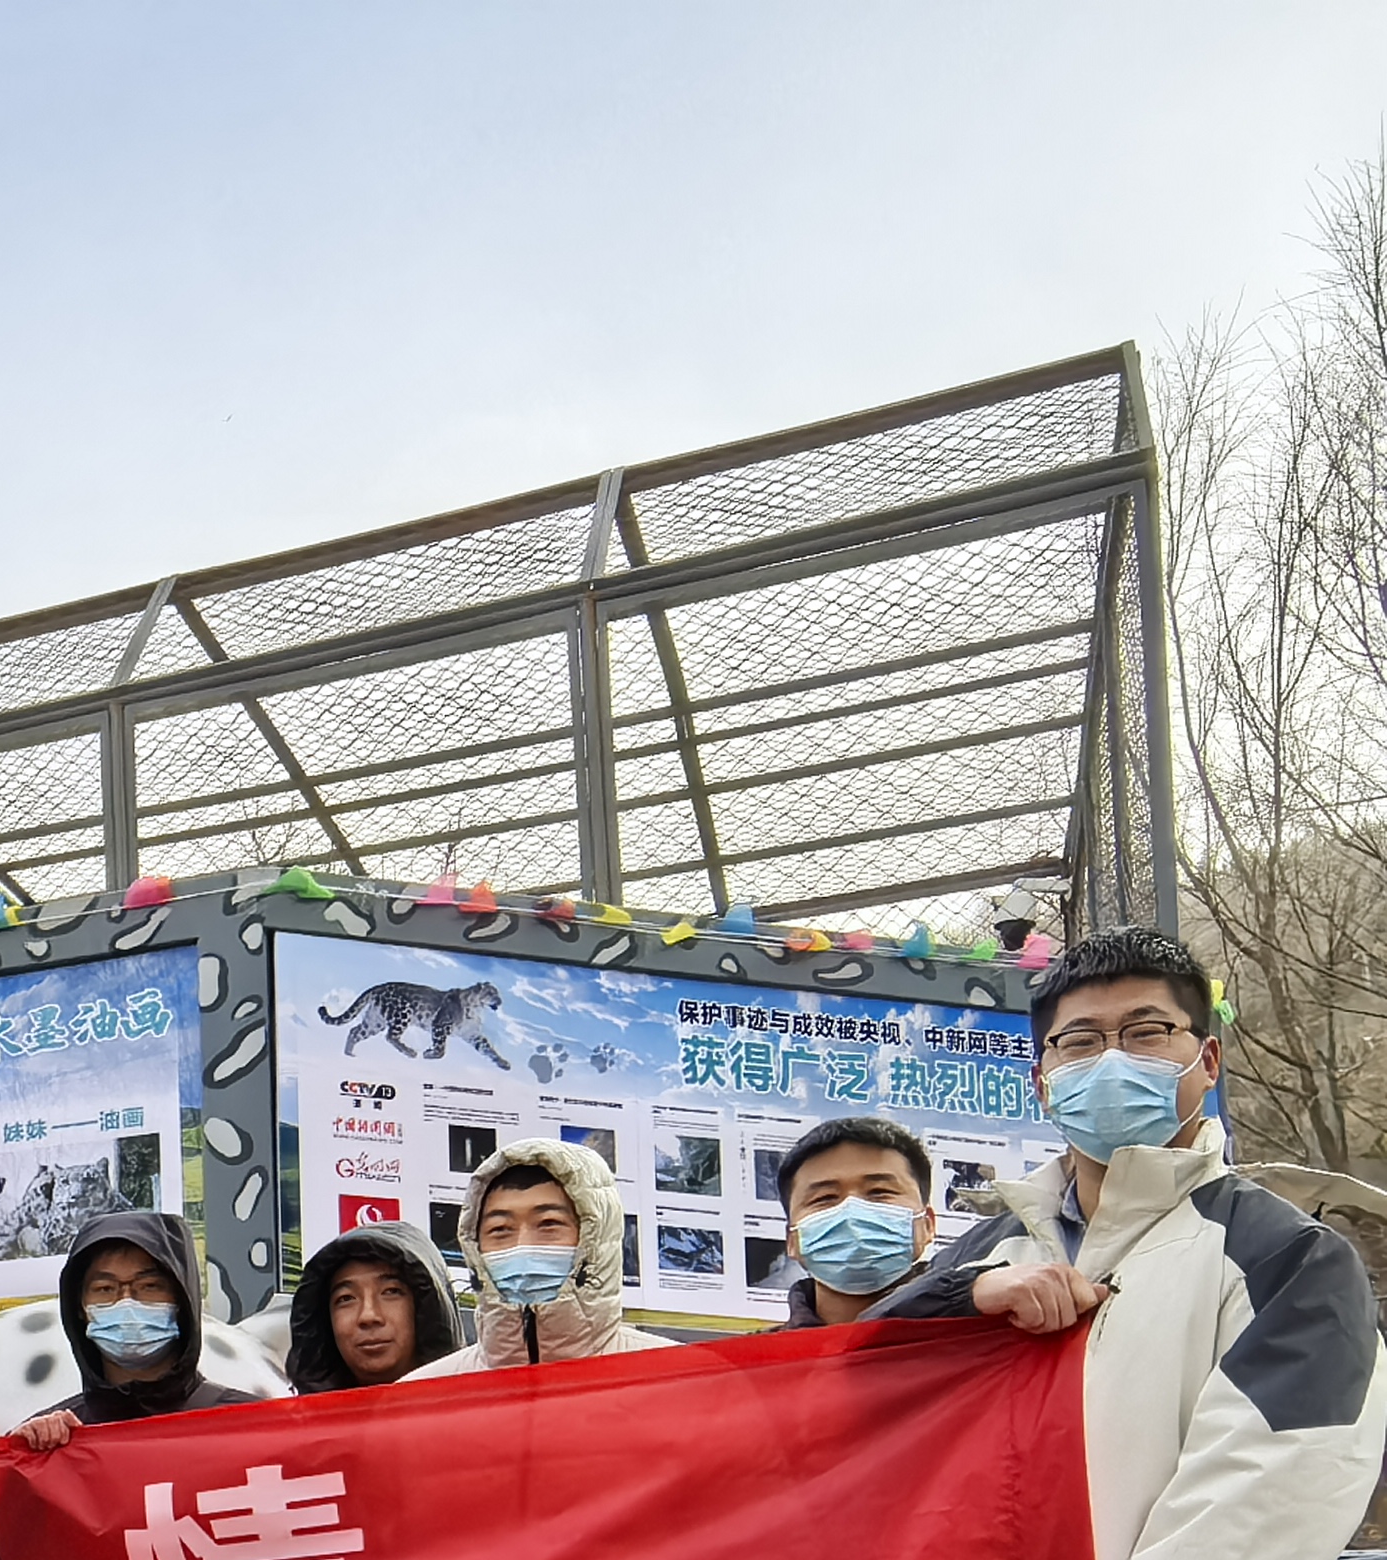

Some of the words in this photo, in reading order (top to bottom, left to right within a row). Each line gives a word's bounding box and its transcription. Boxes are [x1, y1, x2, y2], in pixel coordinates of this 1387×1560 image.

[340, 1081, 376, 1095] CCTV
[681, 1034, 869, 1102] 获得广泛
